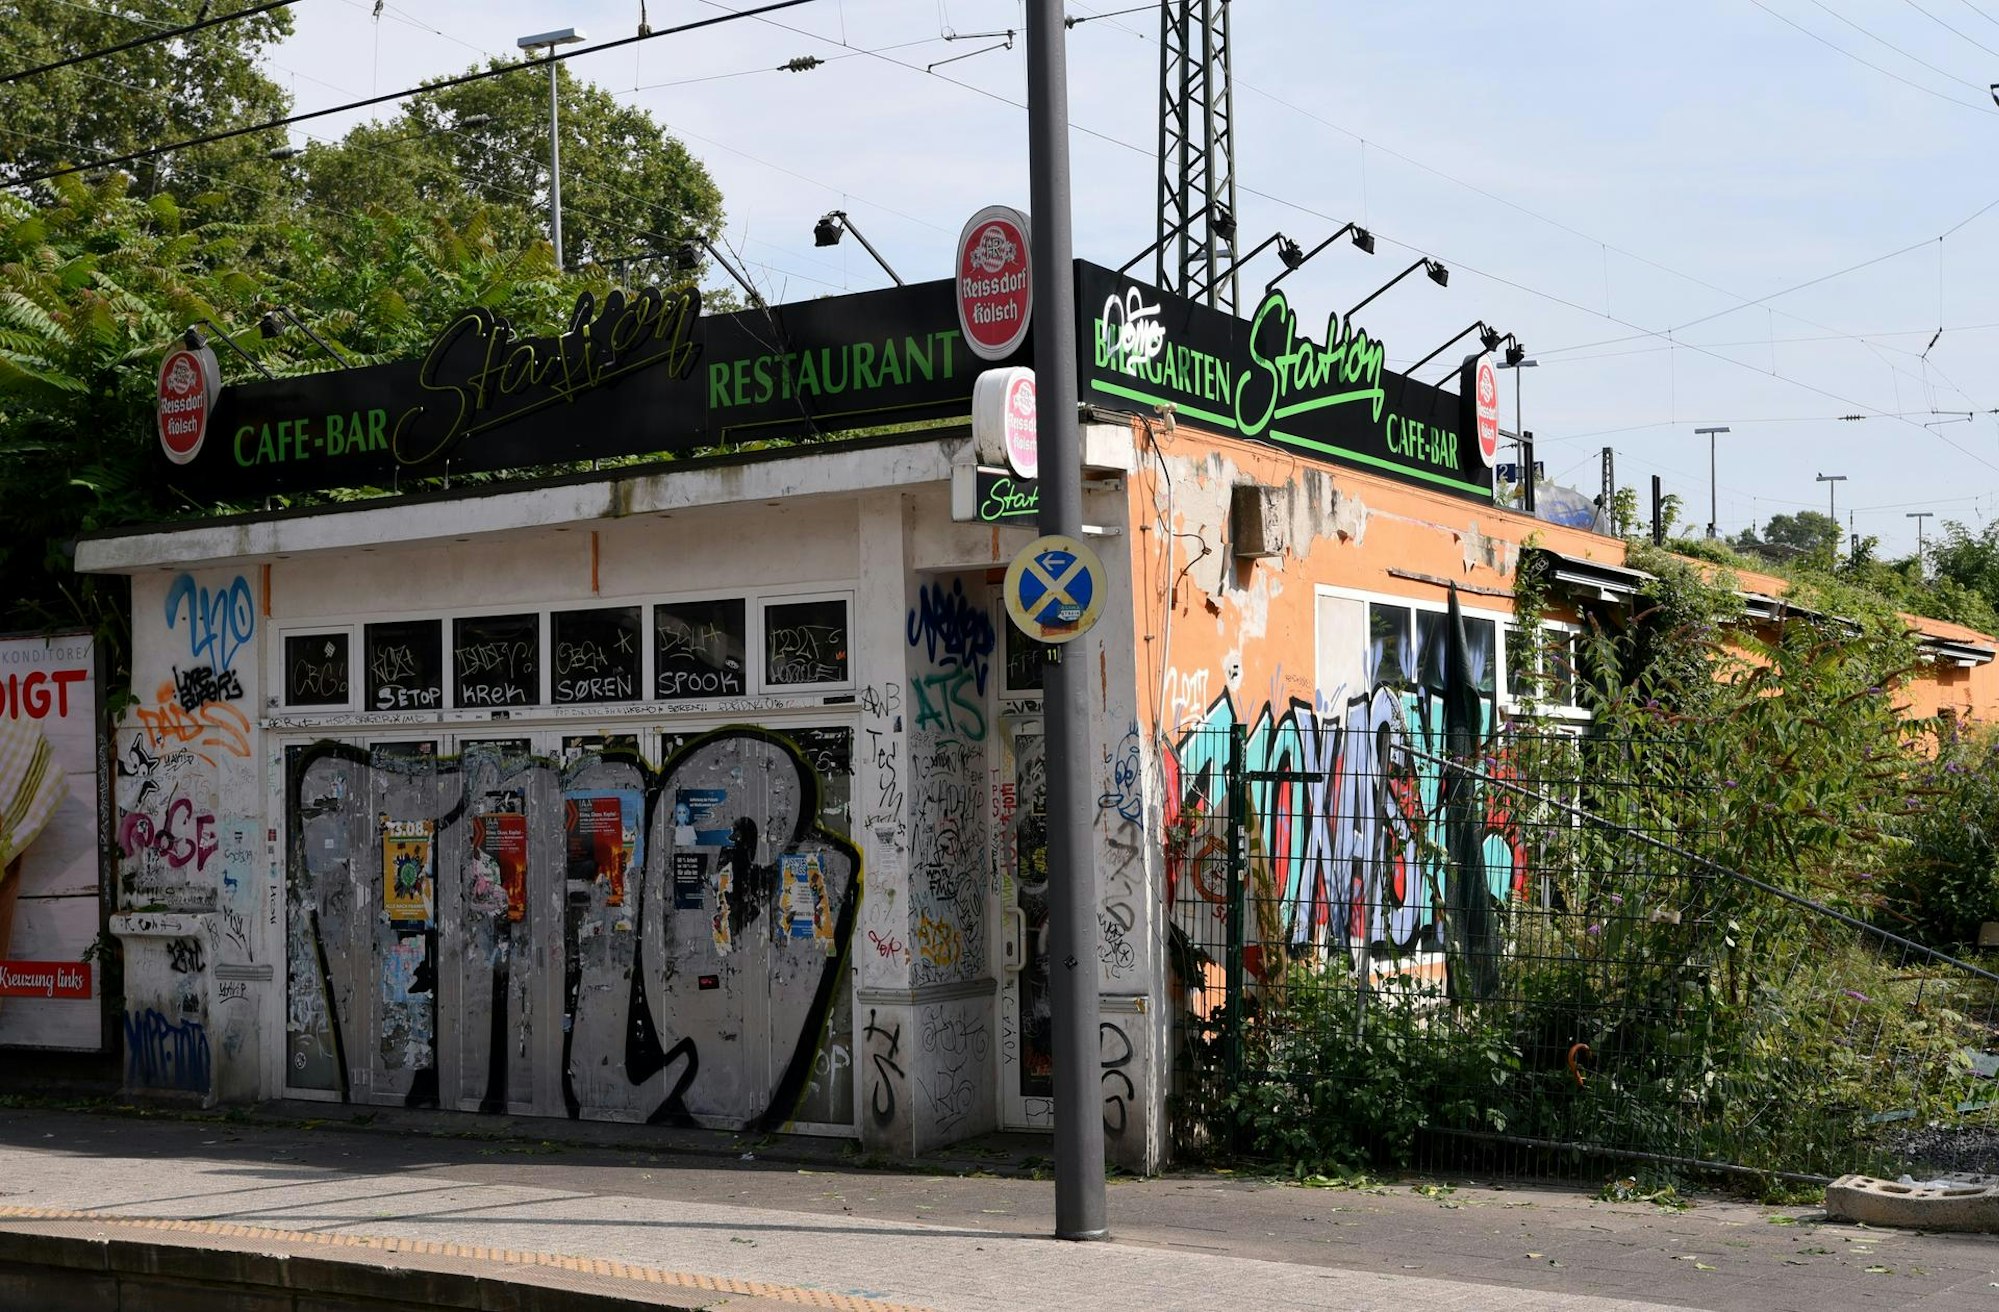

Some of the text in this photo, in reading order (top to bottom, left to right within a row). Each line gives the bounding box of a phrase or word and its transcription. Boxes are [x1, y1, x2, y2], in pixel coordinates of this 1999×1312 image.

[963, 268, 1026, 298] Reissdorf
[974, 299, 1018, 324] Kölsch
[709, 330, 960, 409] RESTAURANT
[1235, 294, 1385, 436] Station
[161, 392, 204, 414] Reissdorf
[168, 416, 198, 435] Kölsch
[234, 409, 389, 467] CAFE-BAR
[1386, 413, 1459, 470] CAFE-BAR
[1499, 464, 1509, 479] 2
[981, 478, 1039, 520] Stat
[0, 669, 88, 720] IGT
[0, 966, 85, 997] Kreuzung links
